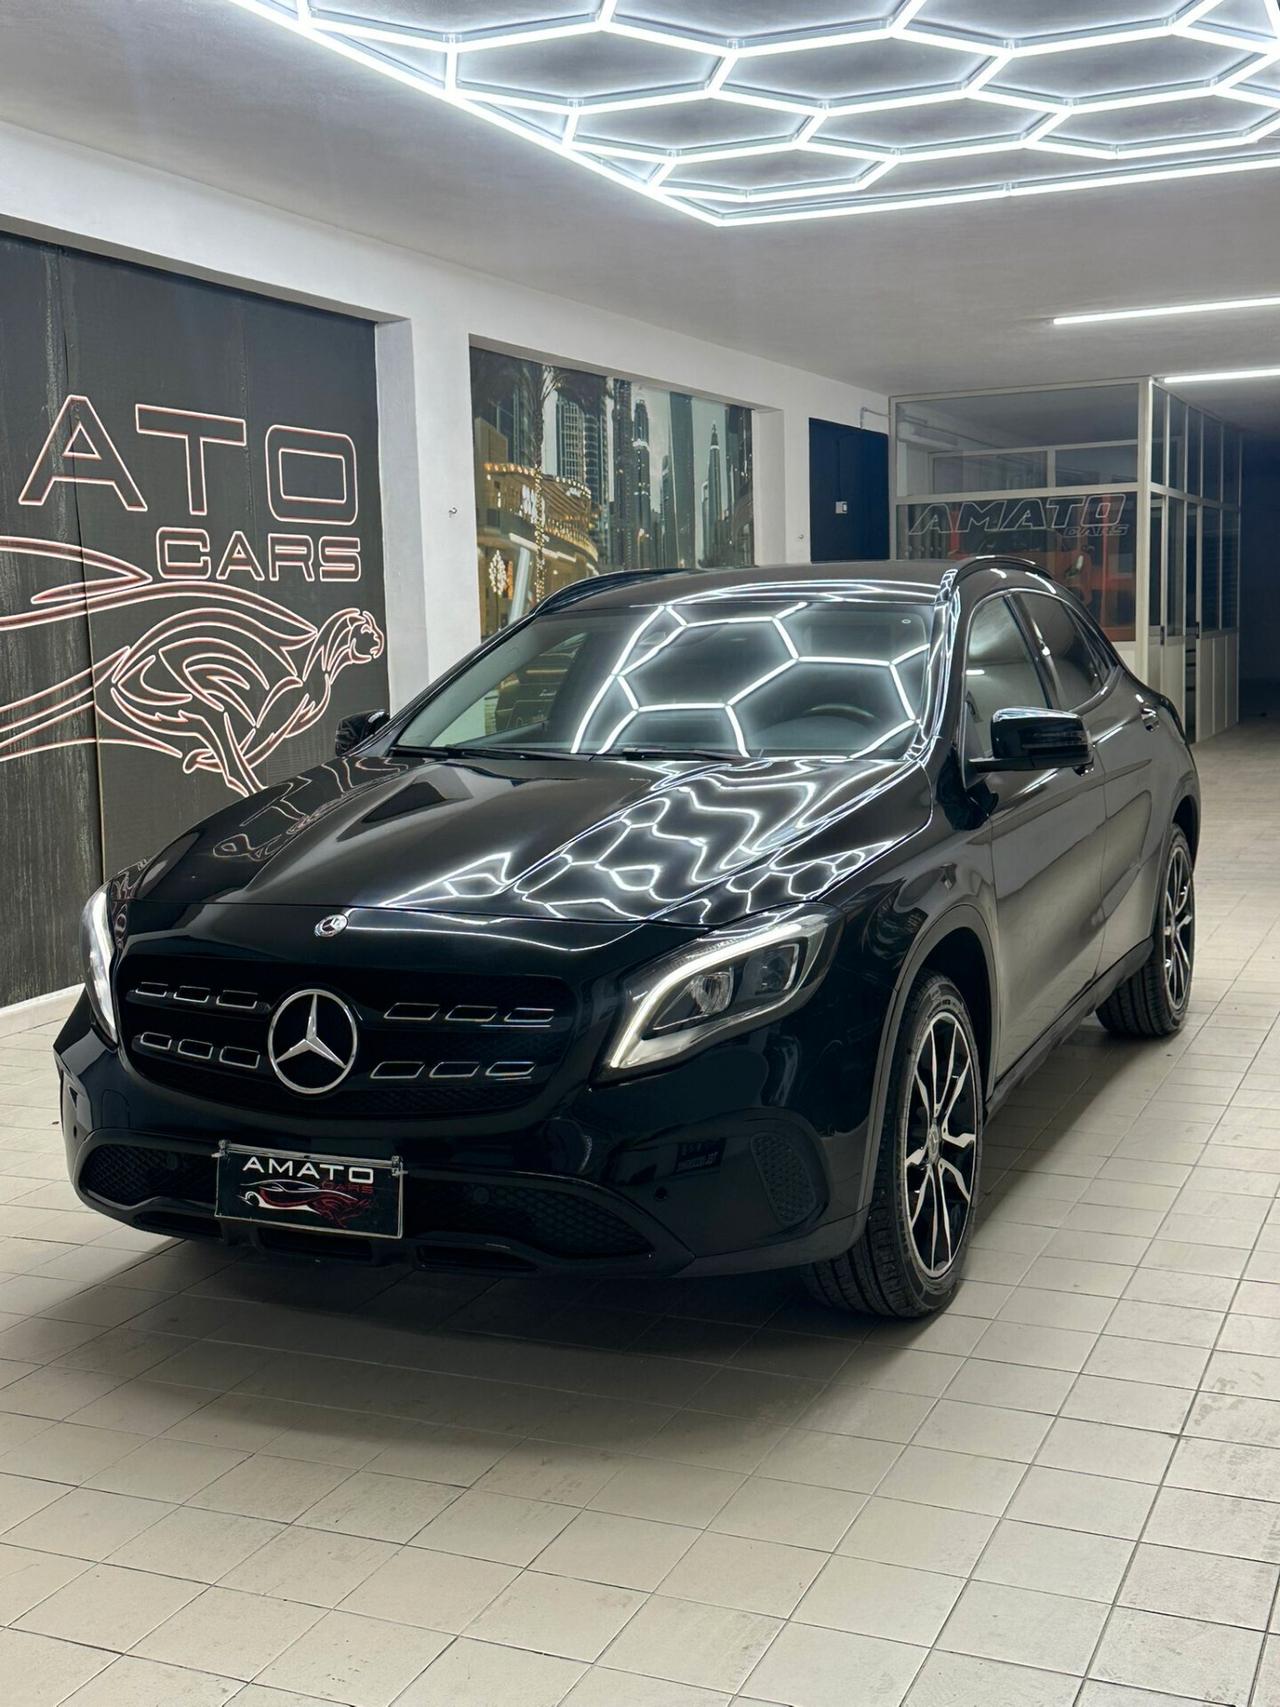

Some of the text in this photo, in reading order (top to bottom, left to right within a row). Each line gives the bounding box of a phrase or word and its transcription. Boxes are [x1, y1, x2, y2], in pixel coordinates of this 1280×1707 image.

[18, 394, 359, 525] ATO
[908, 494, 1126, 535] AMATO
[156, 526, 361, 582] CARS
[242, 1156, 374, 1184] AMATO
[321, 1180, 374, 1194] CARS
